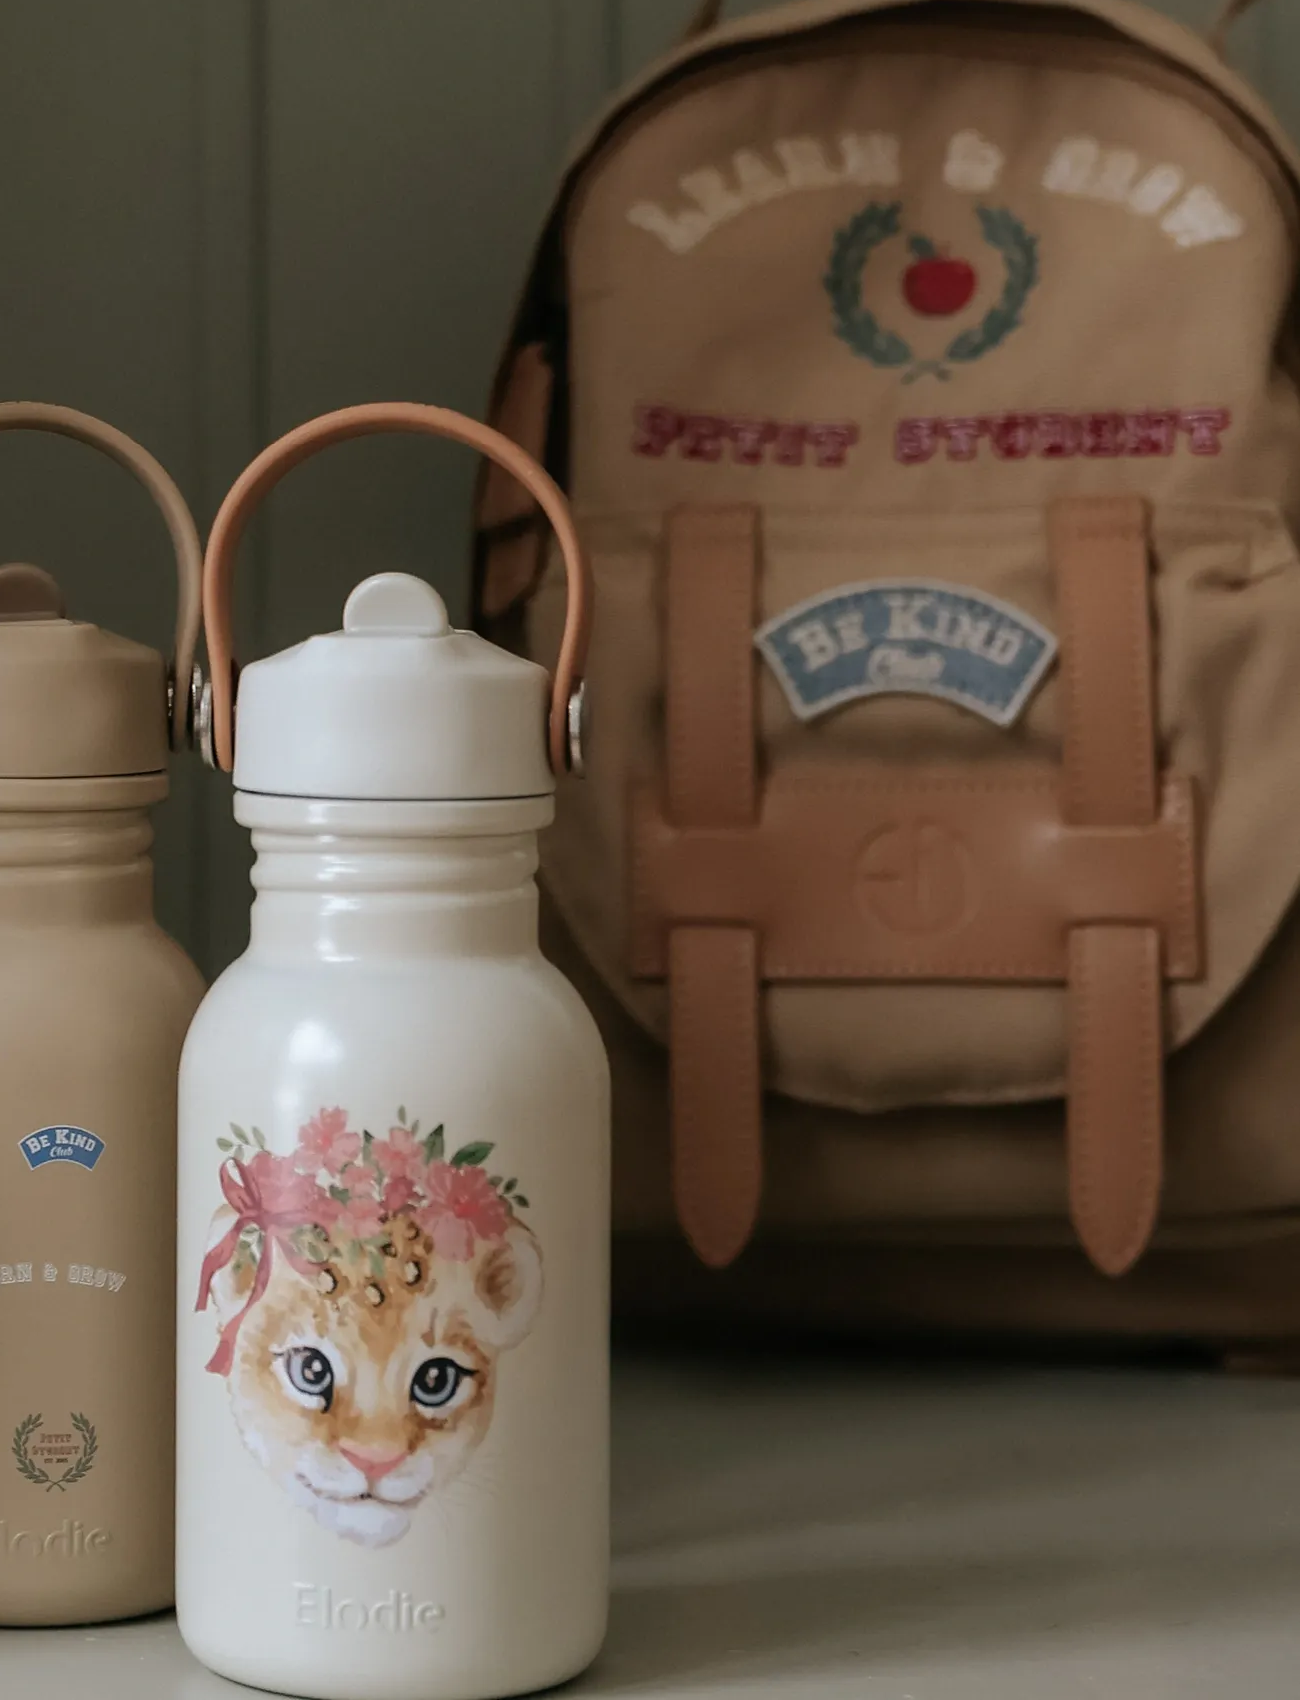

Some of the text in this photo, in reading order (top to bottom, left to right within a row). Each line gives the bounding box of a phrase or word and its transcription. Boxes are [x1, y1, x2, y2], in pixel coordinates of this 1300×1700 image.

[787, 592, 1024, 674] BE KIND
[25, 1128, 97, 1155] BE KIND
[49, 1145, 74, 1158] Club
[44, 1263, 58, 1282] &
[68, 1263, 127, 1293] GROW
[292, 1580, 447, 1633] Elodie
